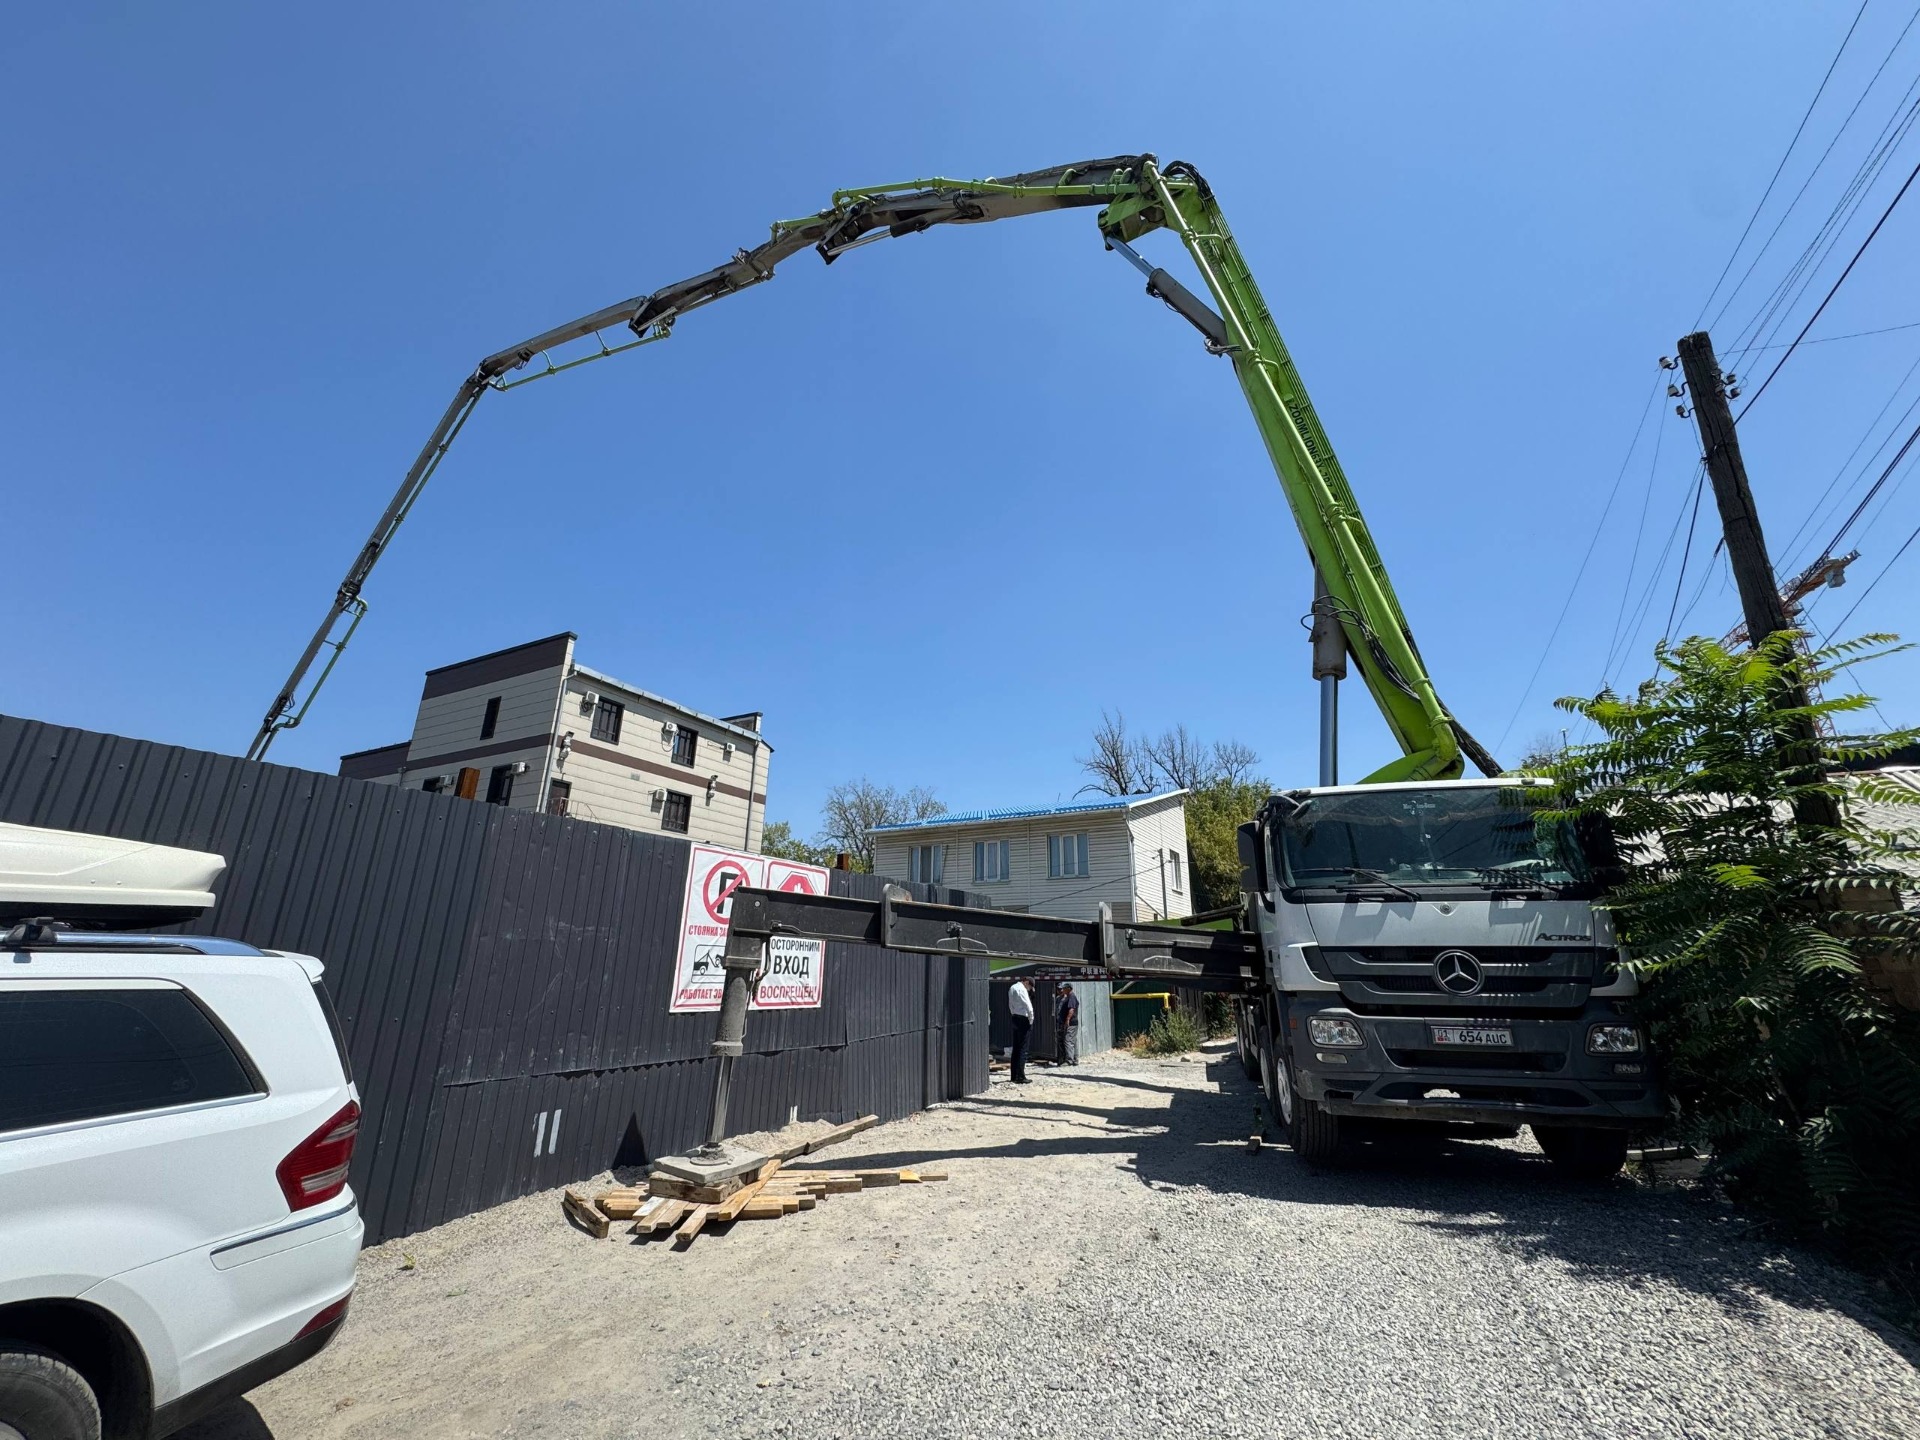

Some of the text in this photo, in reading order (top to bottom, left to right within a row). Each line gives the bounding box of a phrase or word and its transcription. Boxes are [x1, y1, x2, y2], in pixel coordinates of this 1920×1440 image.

[688, 925, 719, 937] СТОЯНКА
[769, 938, 820, 952] ОСТОРОННИМ
[773, 955, 810, 979] ВХОД
[679, 988, 713, 1000] РАБОТАЕТ
[1459, 1031, 1483, 1043] 654
